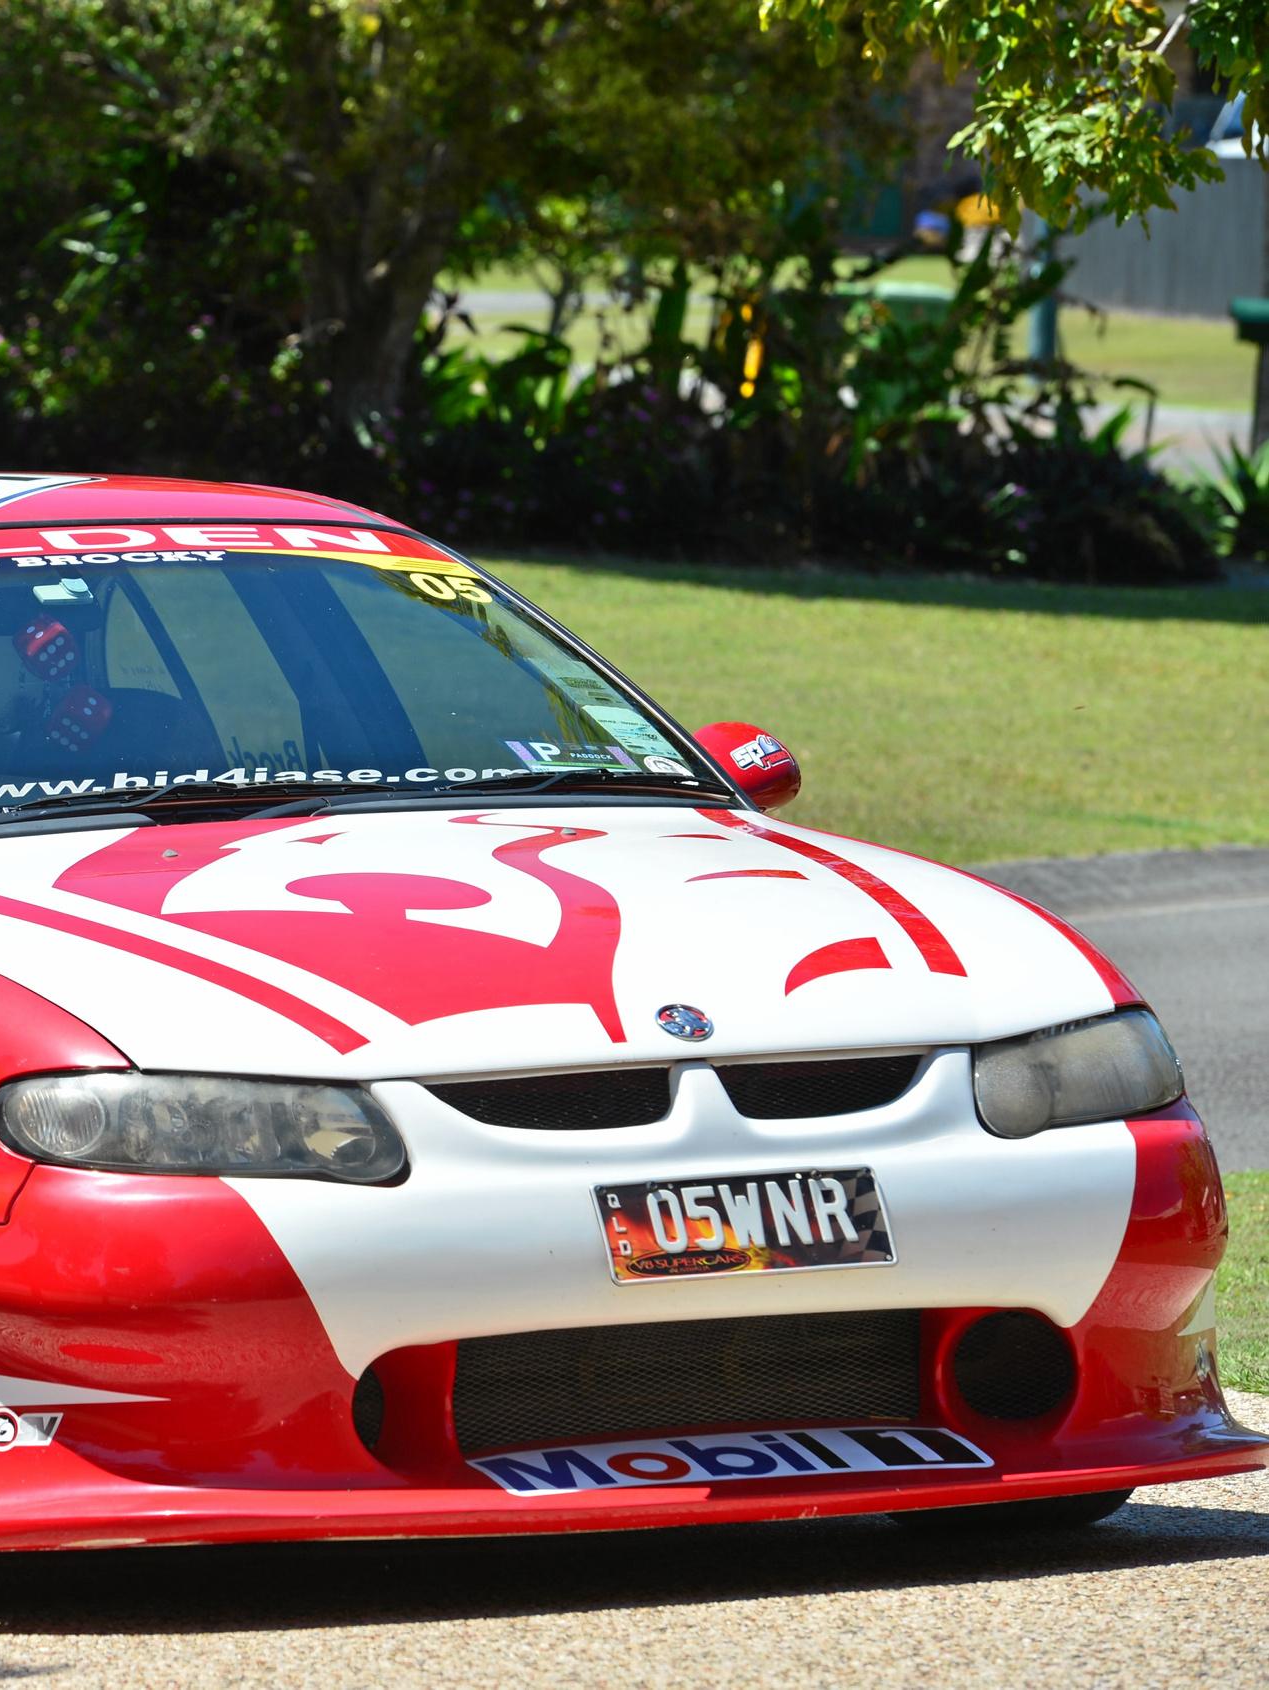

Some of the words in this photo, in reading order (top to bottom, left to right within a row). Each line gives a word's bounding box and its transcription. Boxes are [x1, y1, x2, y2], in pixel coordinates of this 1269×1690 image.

[12, 550, 227, 568] BROCKY
[410, 573, 493, 604] 05
[529, 742, 561, 761] P
[570, 752, 613, 760] PADDOCK
[607, 1193, 633, 1256] QLD
[646, 1178, 860, 1254] 05WNR
[475, 1431, 851, 1492] Mobil
